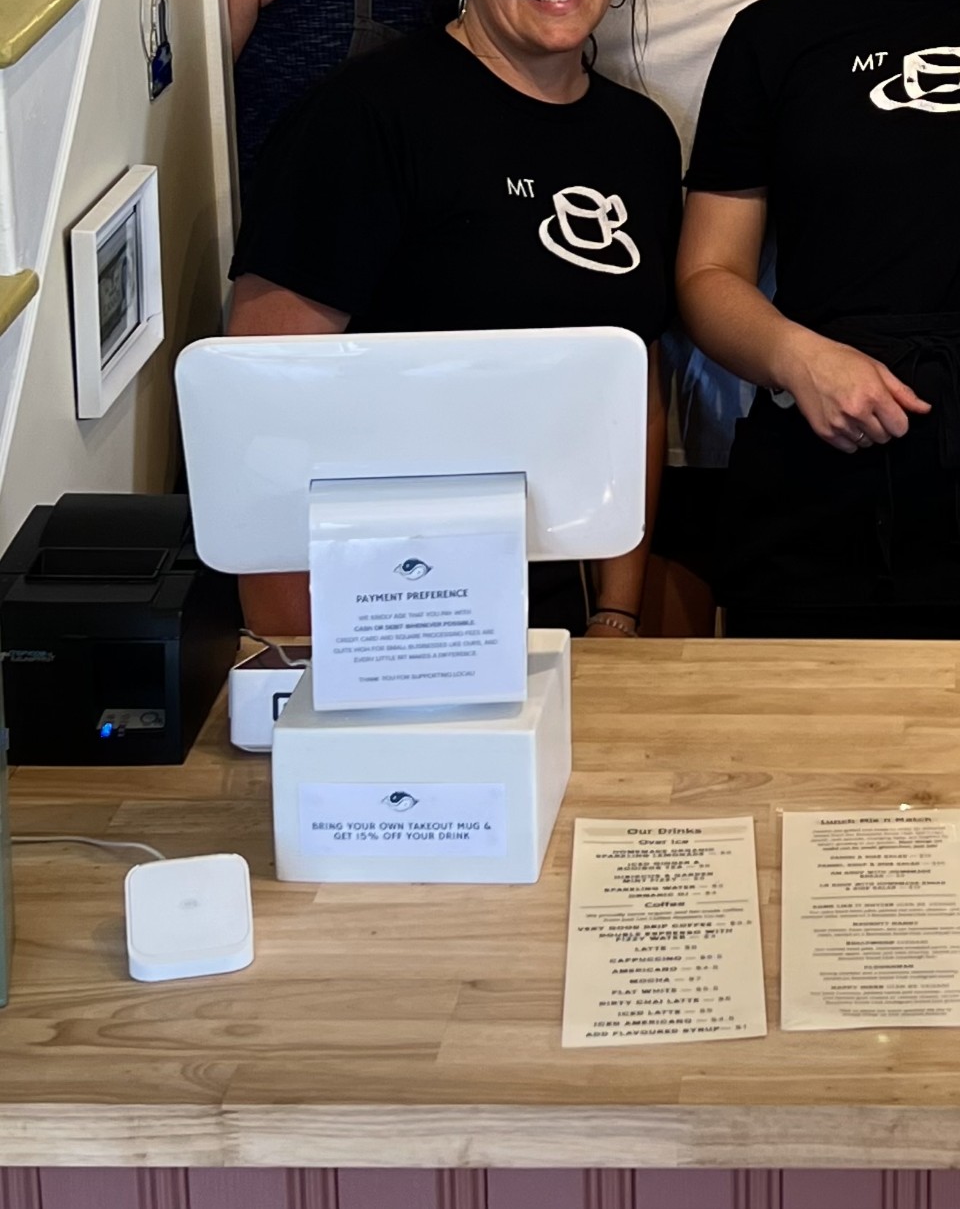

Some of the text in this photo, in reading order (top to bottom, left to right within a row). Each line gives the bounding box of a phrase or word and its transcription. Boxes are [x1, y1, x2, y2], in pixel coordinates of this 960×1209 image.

[852, 51, 889, 73] MT
[506, 177, 535, 199] MT
[356, 589, 469, 603] PAYMENT PREFERENCE
[312, 822, 343, 830] BRING
[347, 822, 376, 830] YOUR
[379, 822, 404, 830] OWN
[408, 822, 453, 830] TAKEOUT
[457, 822, 480, 830] MUG
[334, 832, 470, 840] GET 15% OFF YOUR DRINK
